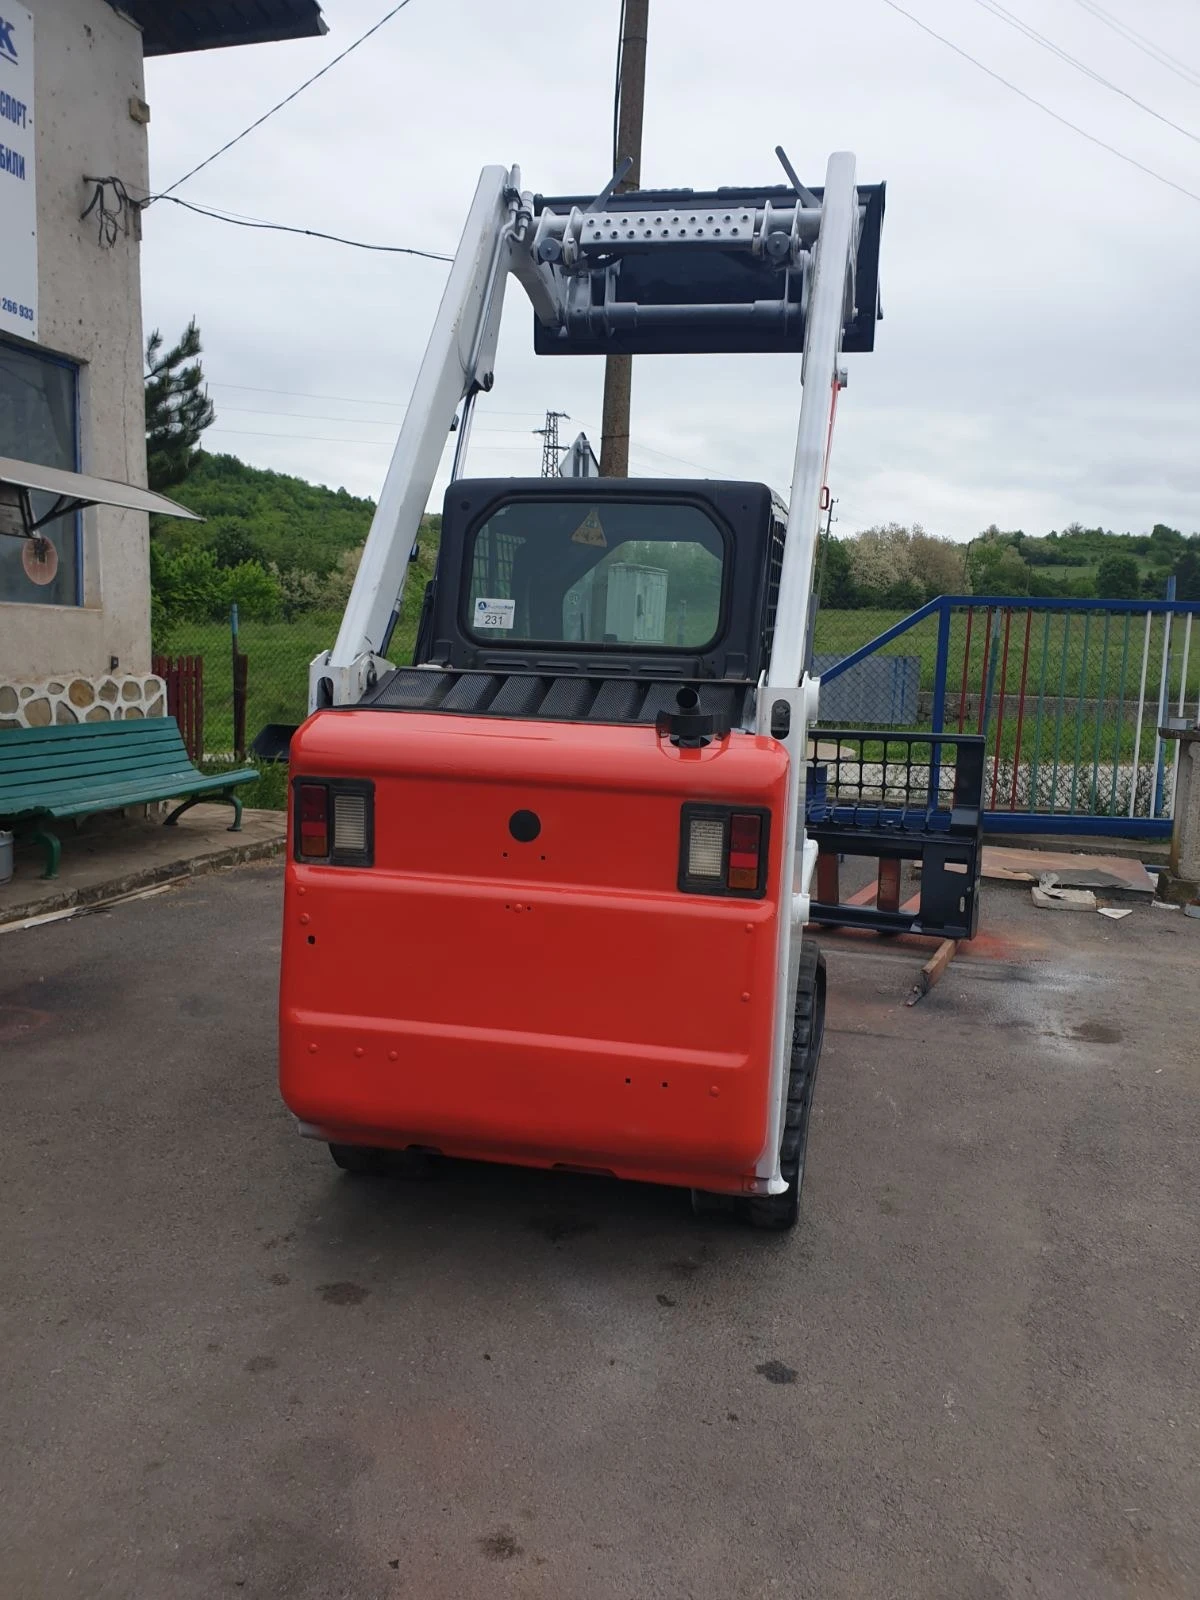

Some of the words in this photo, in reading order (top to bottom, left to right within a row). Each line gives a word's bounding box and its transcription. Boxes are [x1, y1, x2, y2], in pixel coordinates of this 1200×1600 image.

[2, 297, 17, 315] 266
[19, 304, 33, 321] 933
[485, 615, 503, 625] 231
